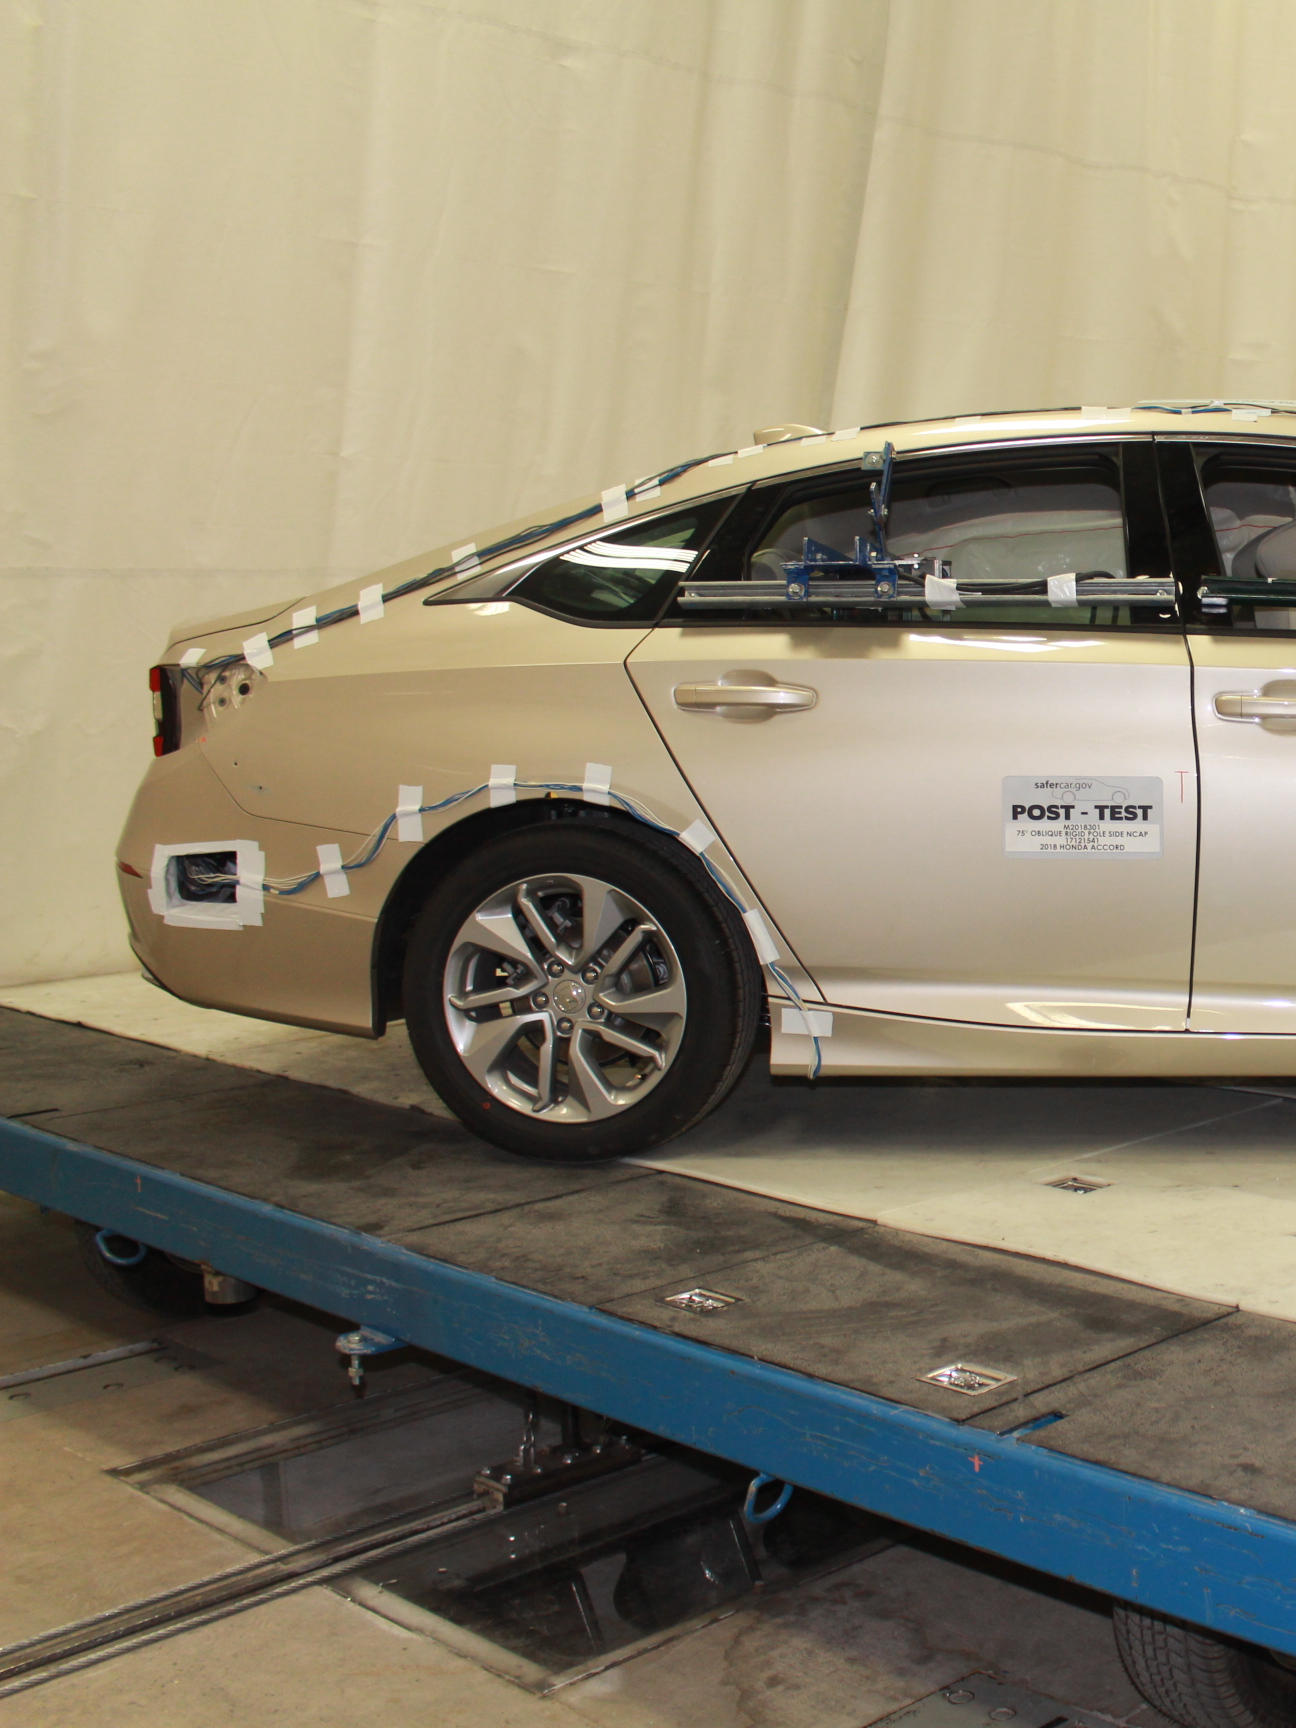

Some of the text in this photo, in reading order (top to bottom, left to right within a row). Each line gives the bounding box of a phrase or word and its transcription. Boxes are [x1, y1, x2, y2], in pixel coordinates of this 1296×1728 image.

[1034, 780, 1093, 791] safercar.gov
[1012, 804, 1075, 821] POST
[1094, 804, 1153, 821] TEST
[1030, 830, 1063, 838] OBLIQUE
[1064, 830, 1086, 838] RIGID
[1087, 830, 1107, 838] POLE
[1108, 830, 1124, 838] SIDE
[1039, 843, 1058, 851] 2018
[1059, 843, 1088, 851] HONDA
